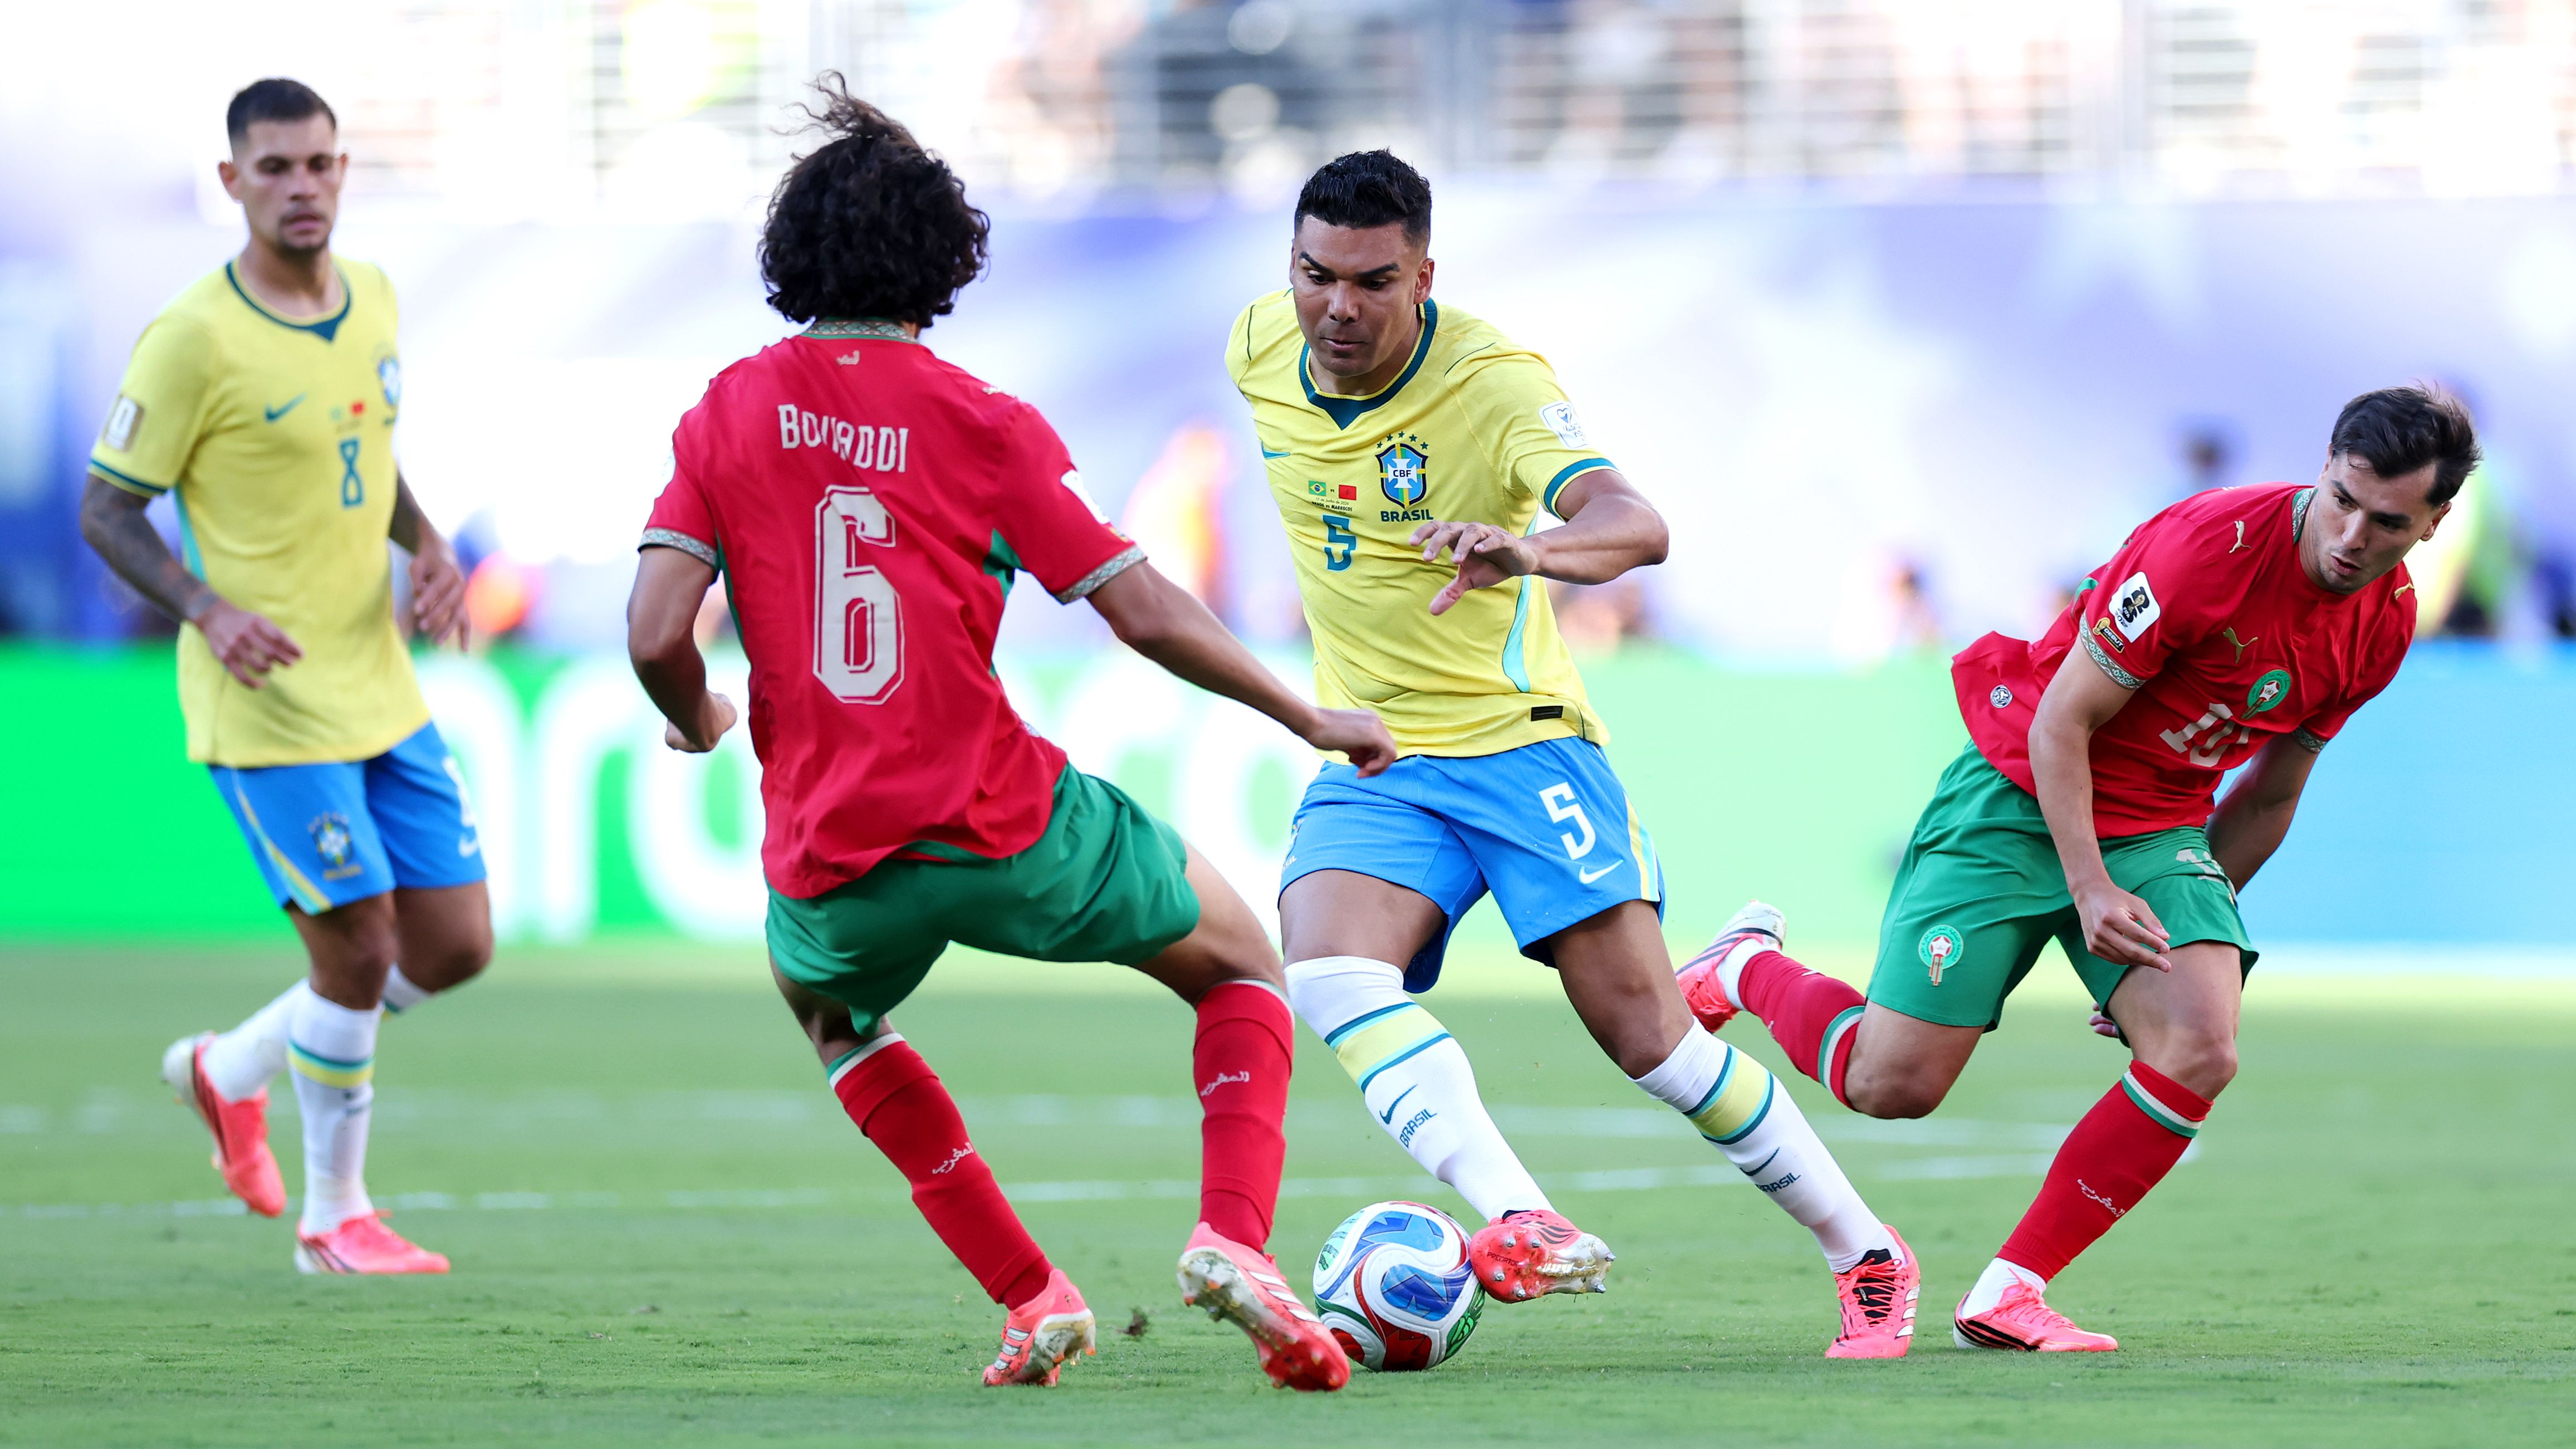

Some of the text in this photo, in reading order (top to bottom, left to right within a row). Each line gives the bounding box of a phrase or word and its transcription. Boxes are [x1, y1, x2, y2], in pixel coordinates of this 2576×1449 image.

[339, 436, 364, 509] 8
[1322, 514, 1357, 572] 5
[1380, 508, 1434, 522] BRASIL
[813, 484, 905, 706] 6
[2103, 627, 2124, 647] DEBUT
[2158, 702, 2252, 768] 10
[1539, 781, 1597, 860] 5
[1399, 1109, 1437, 1148] BRASIL
